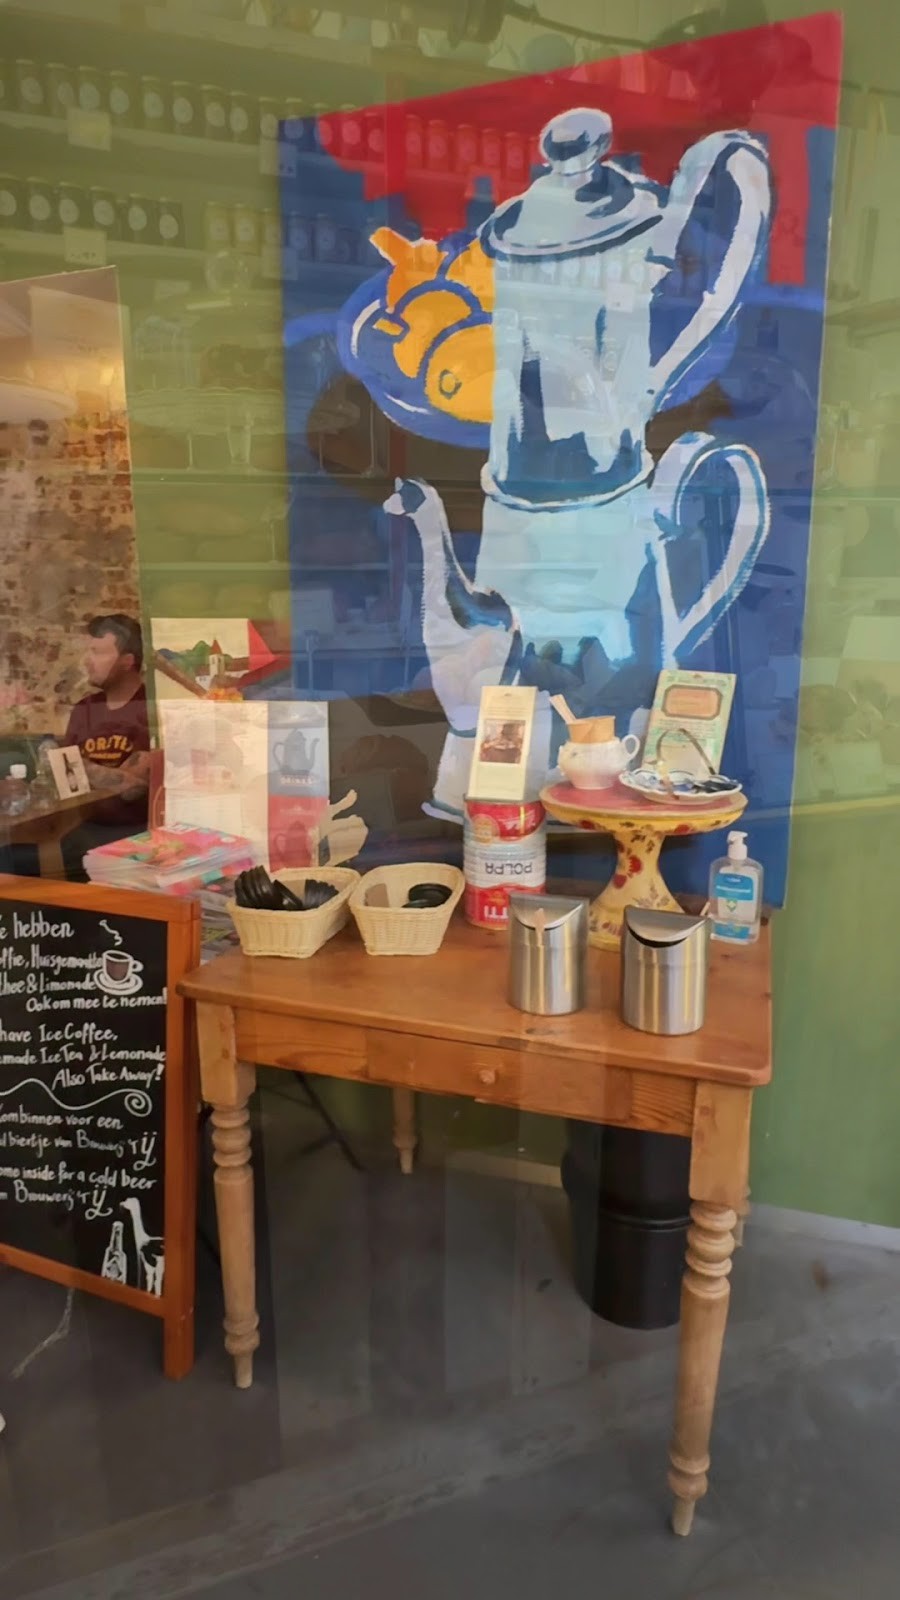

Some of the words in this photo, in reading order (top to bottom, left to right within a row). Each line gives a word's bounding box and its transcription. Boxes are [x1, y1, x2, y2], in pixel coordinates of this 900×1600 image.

[485, 861, 533, 875] POLPA
[484, 905, 509, 919] TTI
[13, 910, 75, 939] hebben
[0, 946, 29, 970] ffie,
[102, 995, 119, 1009] te
[52, 1068, 86, 1091] Also
[85, 1062, 118, 1085] Take
[65, 1114, 94, 1125] voor
[97, 1116, 124, 1130] een
[8, 1131, 52, 1158] biertje
[76, 1170, 86, 1182] a
[88, 1166, 118, 1188] cold
[121, 1168, 158, 1190] beer
